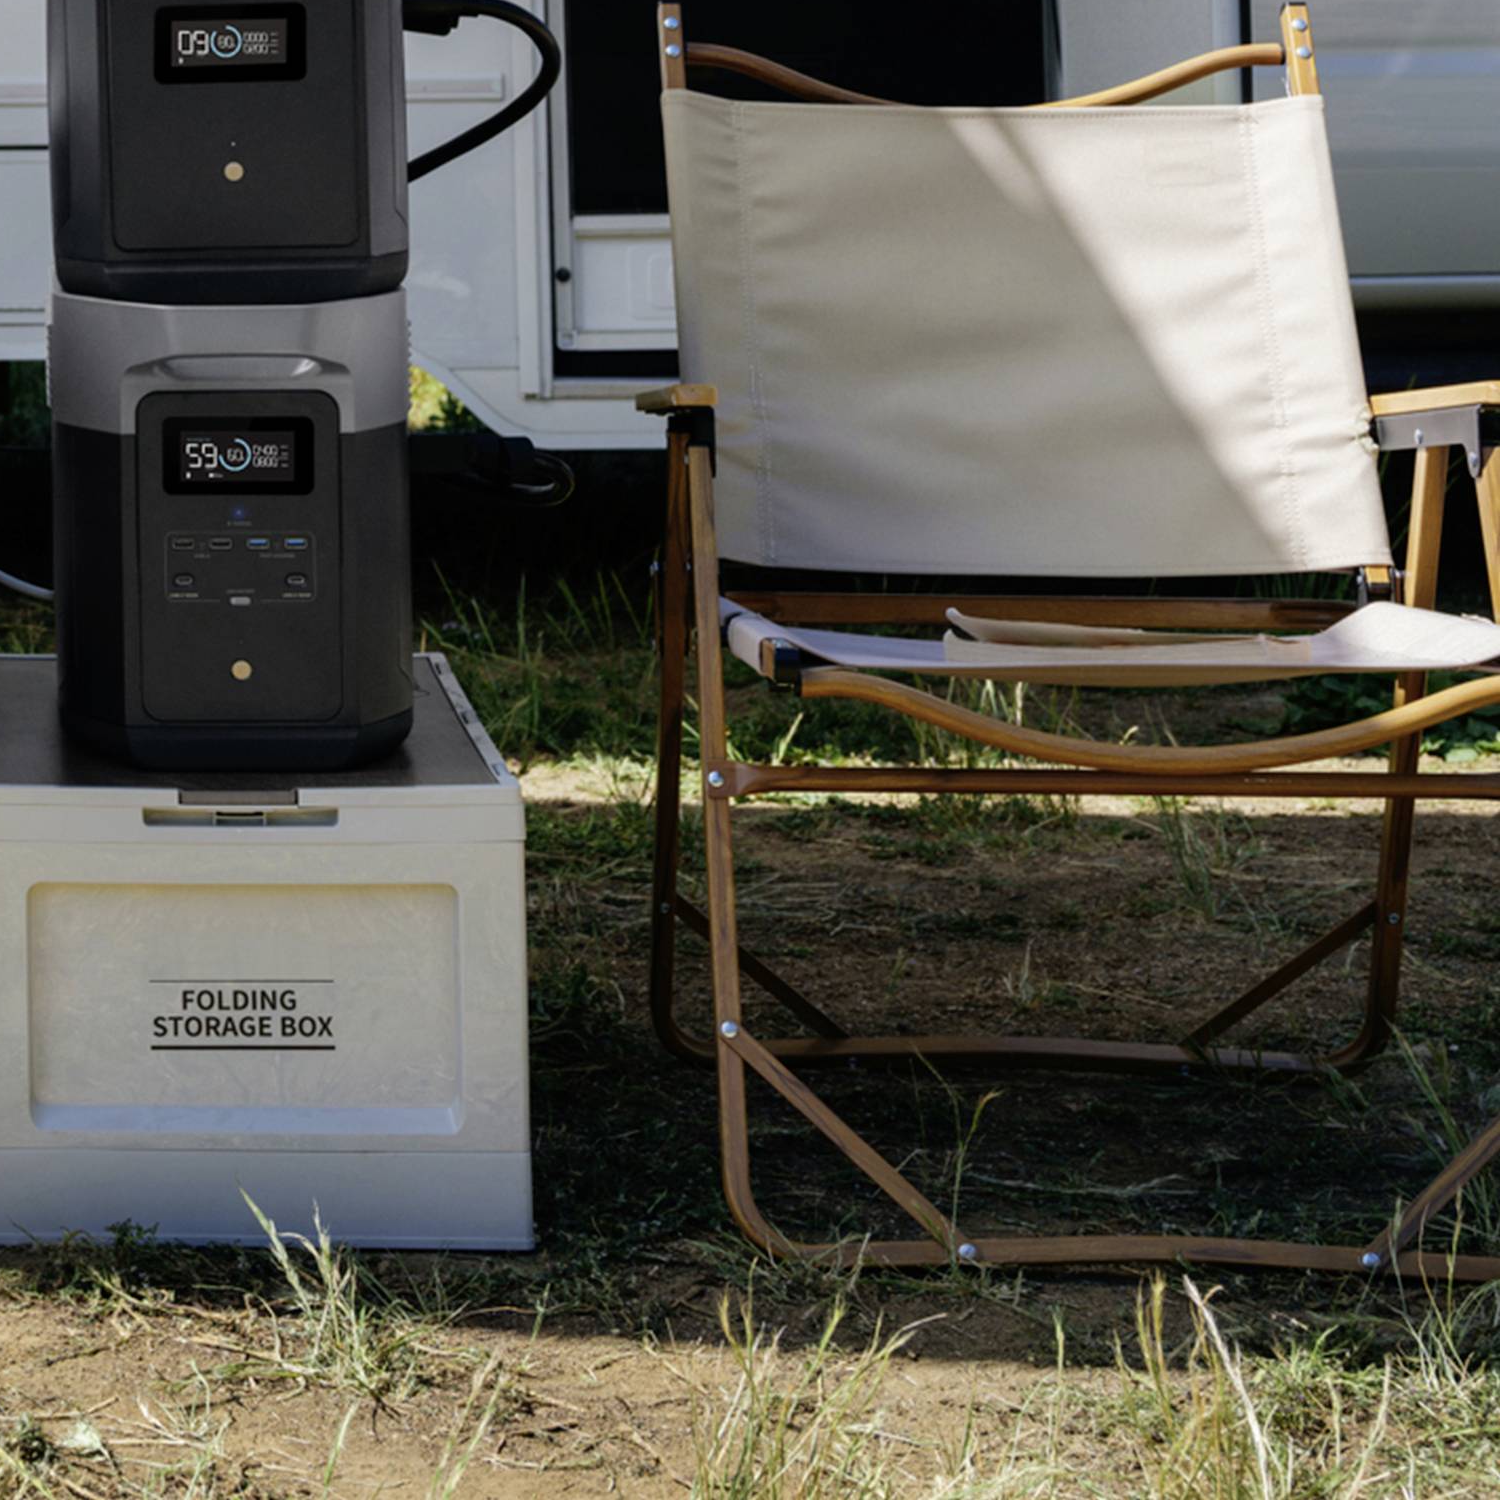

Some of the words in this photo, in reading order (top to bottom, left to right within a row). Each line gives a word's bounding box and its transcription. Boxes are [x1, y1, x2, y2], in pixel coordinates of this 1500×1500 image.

[177, 29, 209, 56] 09
[185, 442, 218, 469] 59
[182, 989, 297, 1011] FOLDING
[153, 1015, 273, 1038] STORAGE
[280, 1015, 333, 1038] BOX
